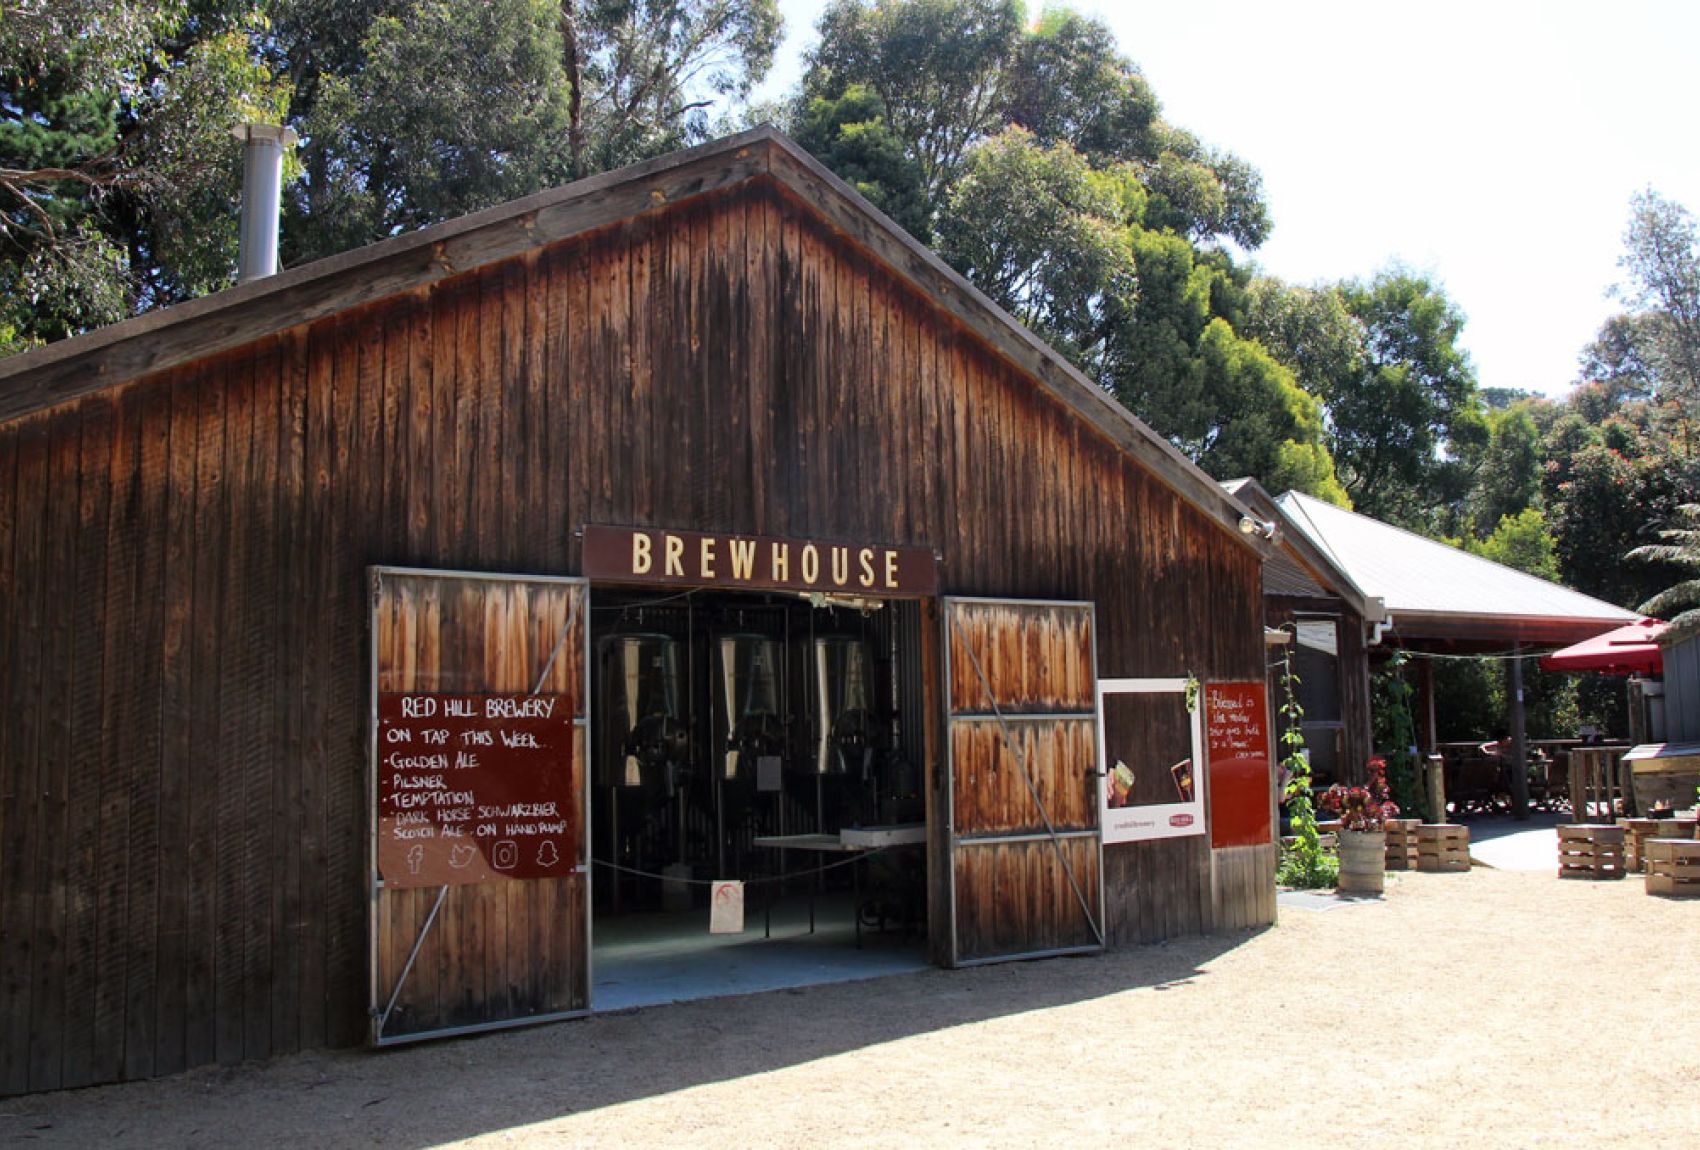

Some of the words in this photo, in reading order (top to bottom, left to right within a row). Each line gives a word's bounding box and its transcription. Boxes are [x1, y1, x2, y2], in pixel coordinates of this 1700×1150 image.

[632, 532, 899, 588] BREWHOUSE
[401, 697, 437, 718] RED
[444, 698, 479, 717] HILL
[485, 697, 556, 718] BREWERY
[386, 729, 412, 744] ON
[420, 729, 450, 745] TAP
[460, 729, 494, 746] THIS
[390, 790, 475, 808] TEMPTATION
[476, 826, 497, 837] ON
